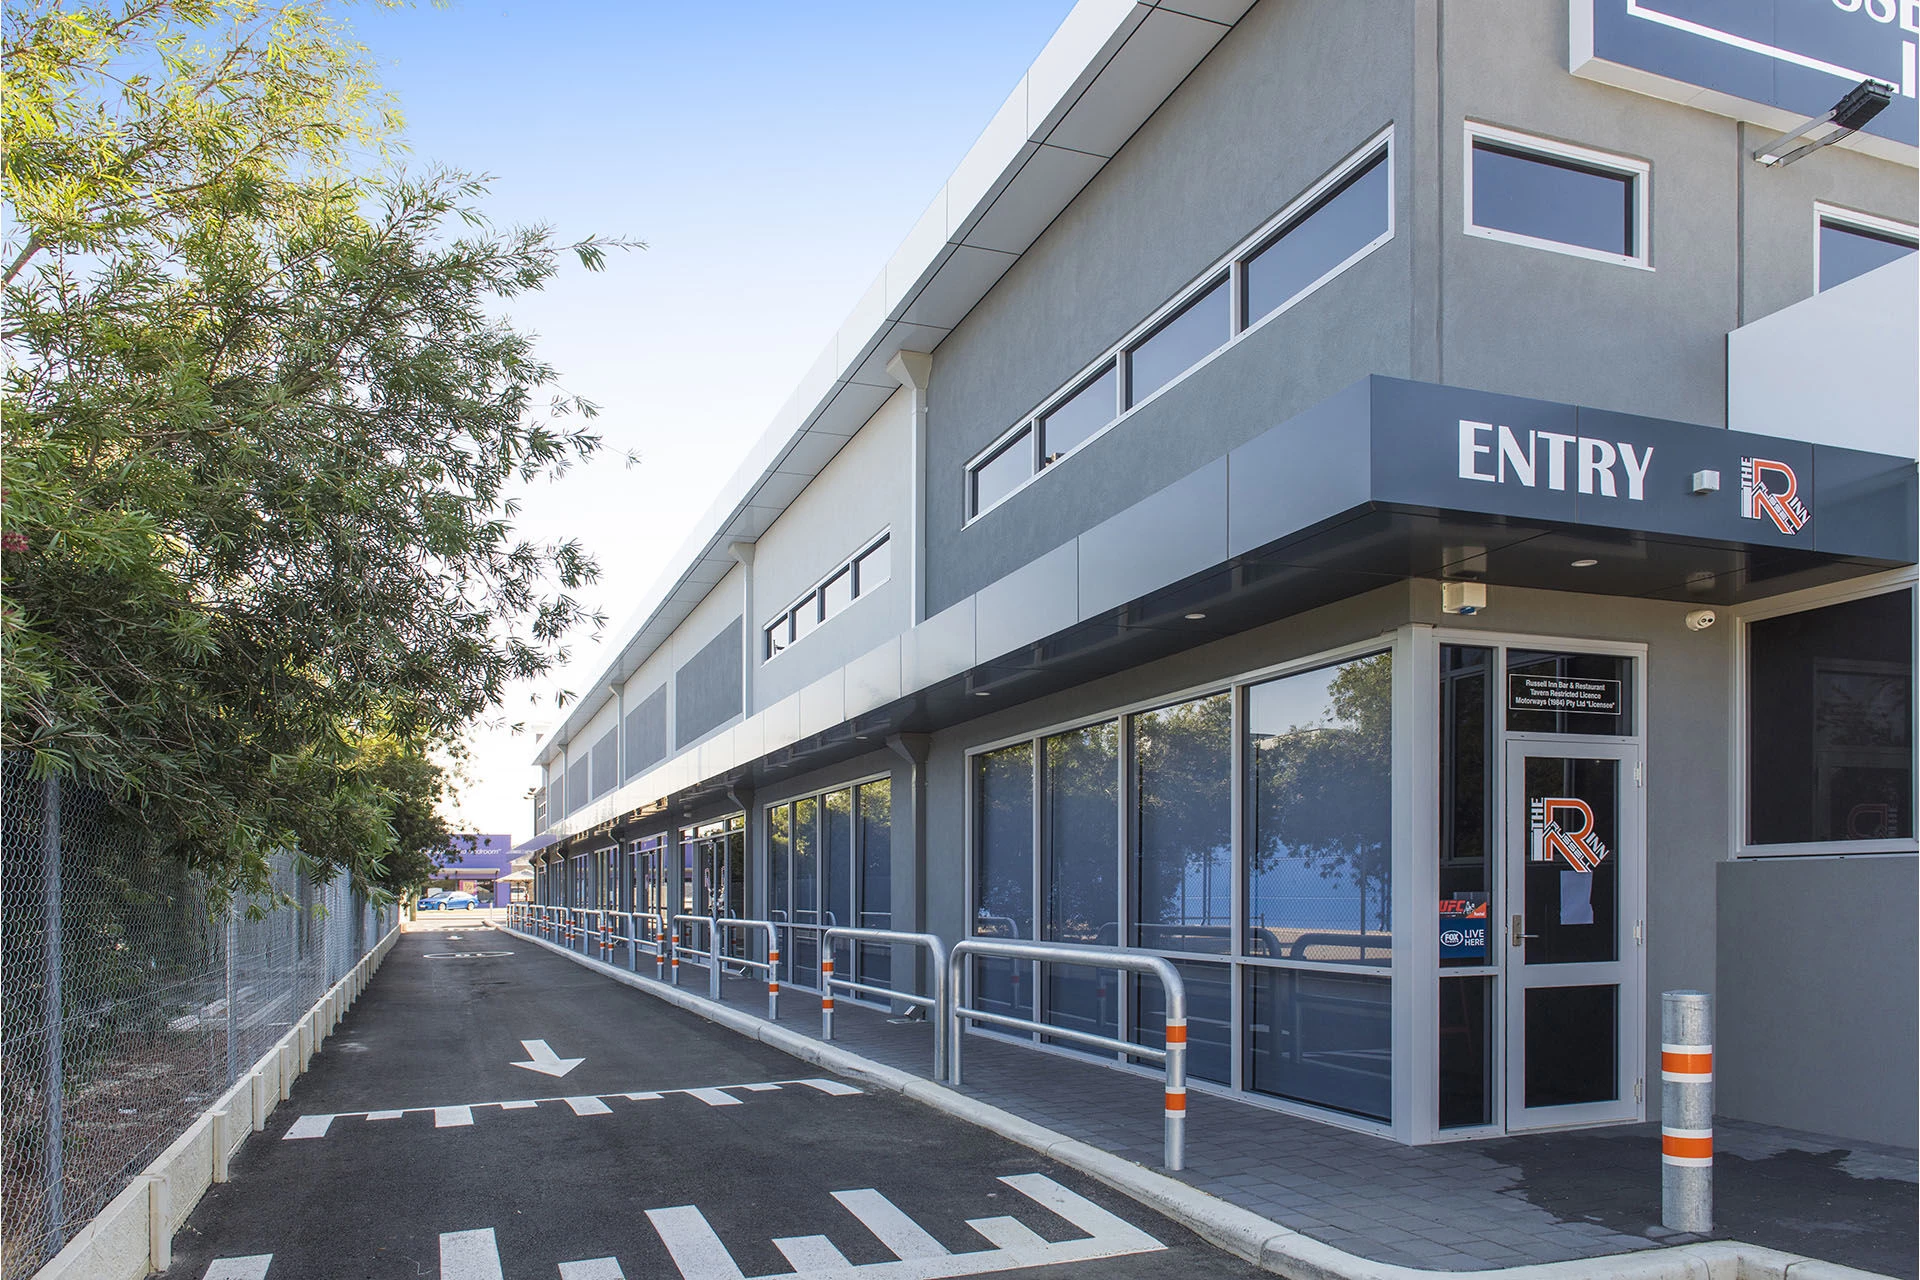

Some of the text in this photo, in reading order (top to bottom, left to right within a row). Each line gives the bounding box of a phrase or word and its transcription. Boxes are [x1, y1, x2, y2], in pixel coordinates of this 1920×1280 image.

[1459, 419, 1655, 501] ENTRY
[1789, 496, 1812, 524] INN
[1525, 679, 1547, 688] Russell
[1548, 680, 1558, 688] Inn
[1558, 681, 1569, 689] Bar
[1575, 682, 1606, 691] Restaurant
[1530, 688, 1602, 700] Tavern Restricted Licence
[1515, 696, 1547, 707] Motorways
[1565, 699, 1576, 708] Pty
[1585, 831, 1610, 861] INN
[1440, 900, 1466, 913] UFC
[1444, 933, 1460, 942] FOX
[1464, 929, 1485, 939] LIVE
[1464, 938, 1485, 947] HERE
